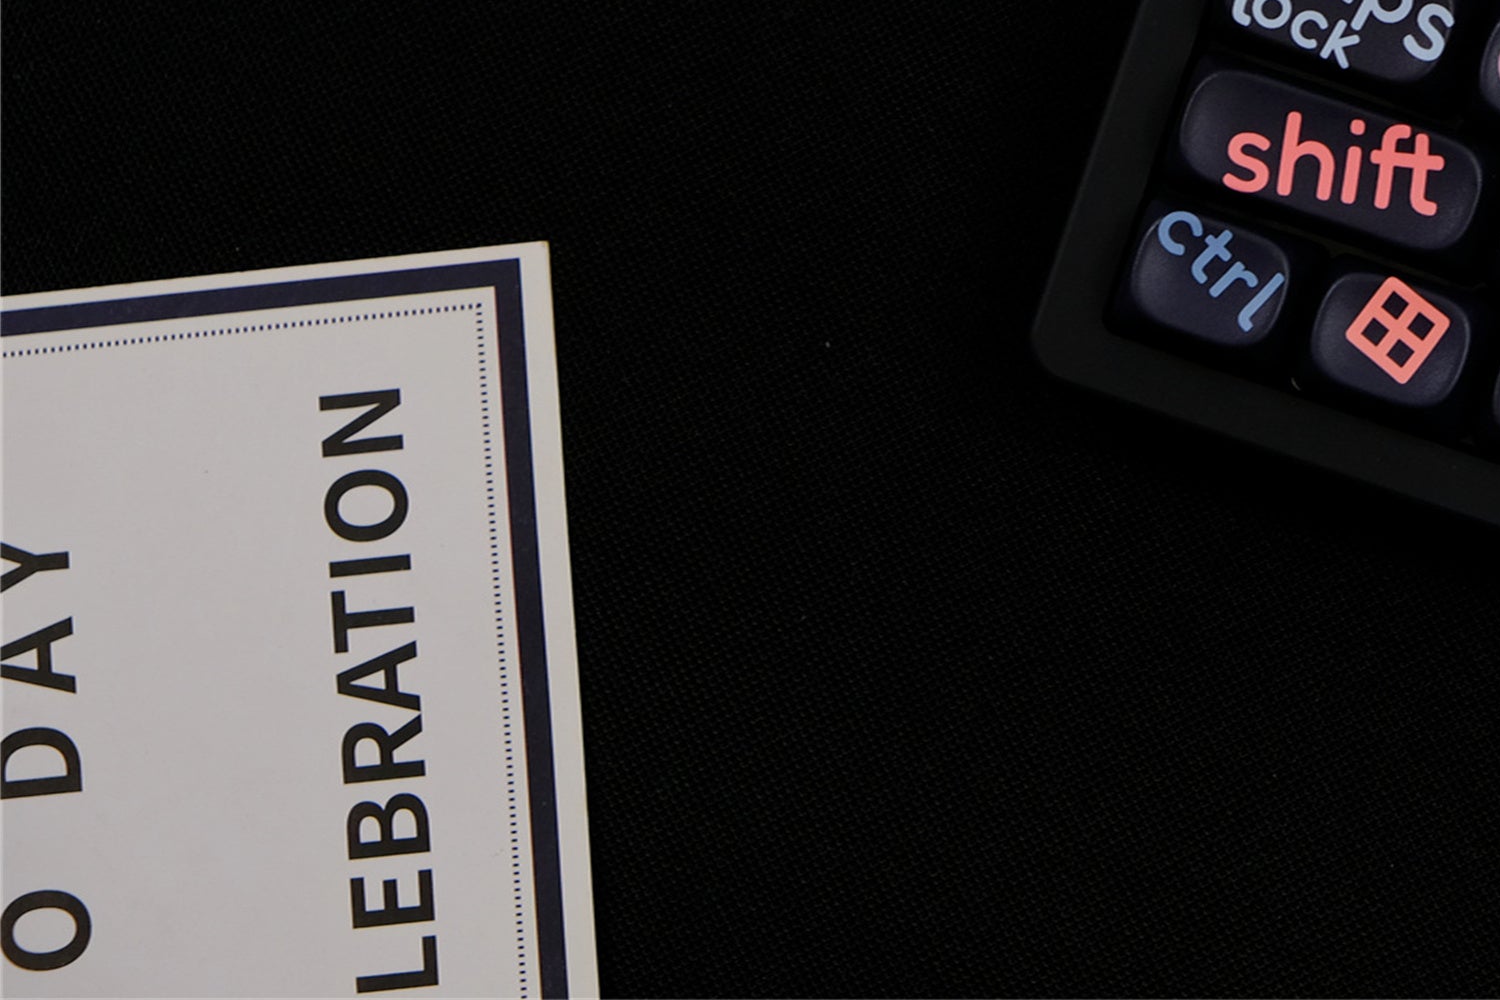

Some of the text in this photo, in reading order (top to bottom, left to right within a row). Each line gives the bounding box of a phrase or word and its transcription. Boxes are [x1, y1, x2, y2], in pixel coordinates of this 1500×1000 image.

[1223, 111, 1445, 216] shift
[1158, 211, 1285, 332] ctrl
[0, 542, 83, 799] DAY
[318, 388, 440, 994] LEBRATION
